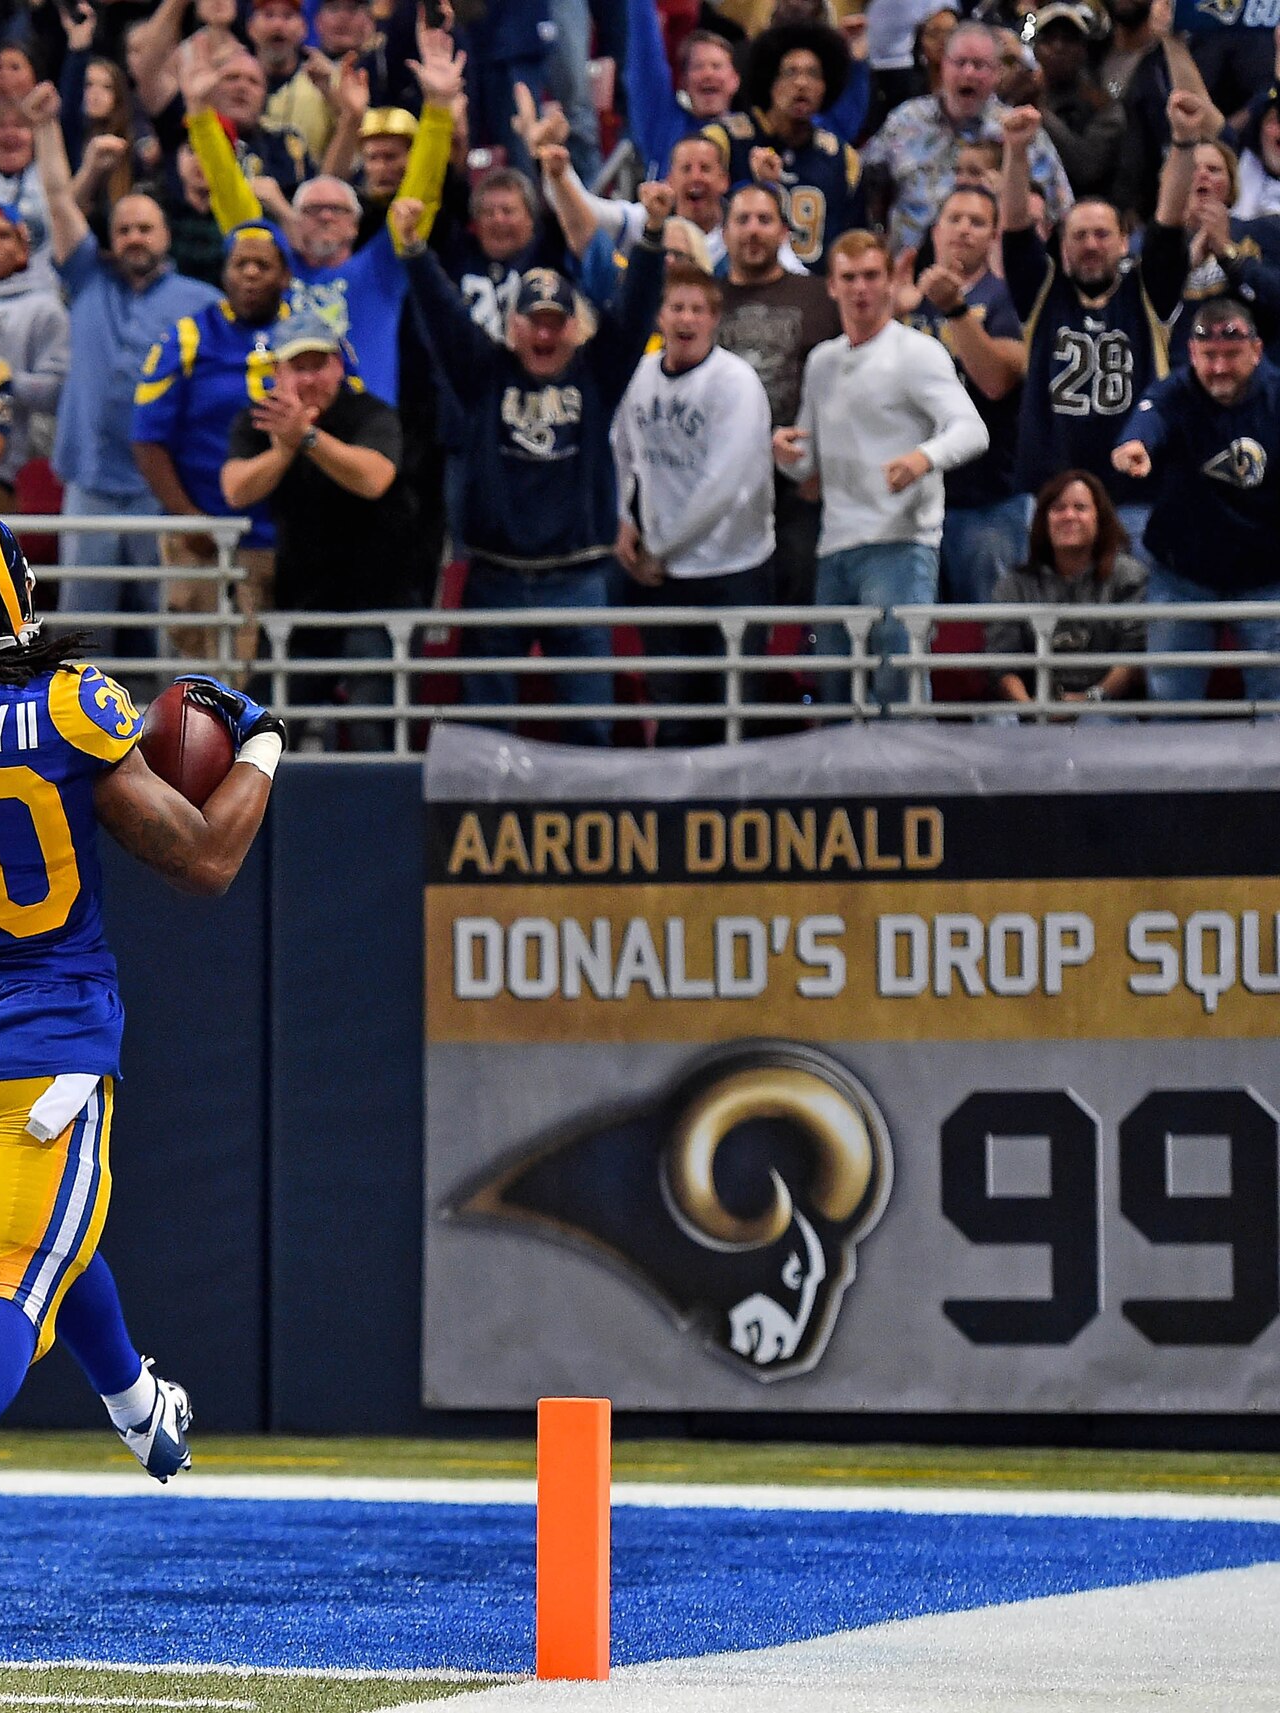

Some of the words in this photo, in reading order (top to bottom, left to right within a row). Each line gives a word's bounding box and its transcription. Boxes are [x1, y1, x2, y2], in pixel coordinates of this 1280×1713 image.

[1049, 326, 1134, 415] 28
[16, 701, 38, 750] II
[448, 811, 659, 874] AARON
[685, 806, 944, 873] DONALD
[453, 914, 847, 1000] DONALD'S
[877, 911, 1095, 997] DROP
[940, 1088, 1280, 1345] 99
